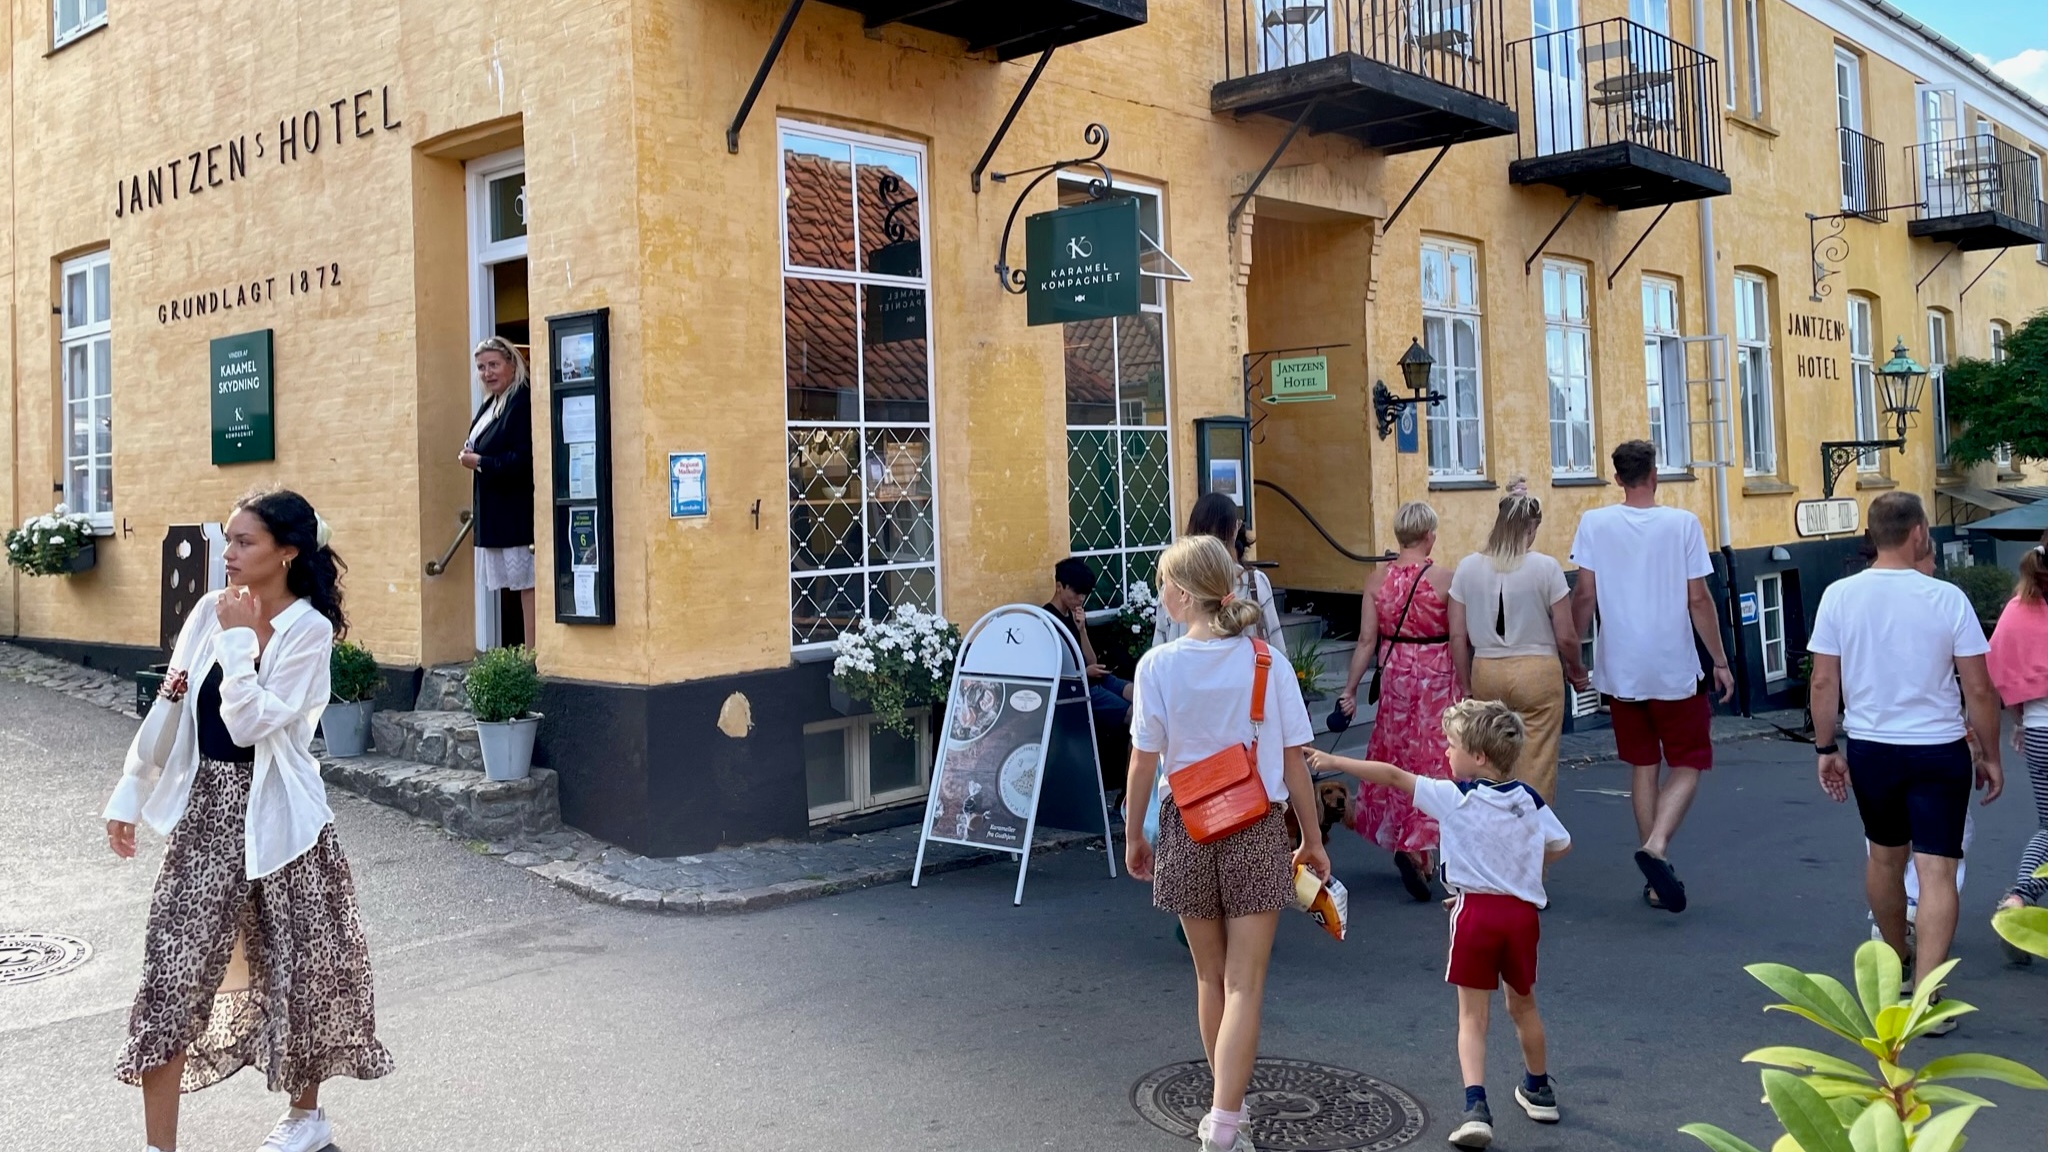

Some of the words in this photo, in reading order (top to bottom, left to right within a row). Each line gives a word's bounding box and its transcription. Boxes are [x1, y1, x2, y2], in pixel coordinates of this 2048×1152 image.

[279, 85, 401, 164] HOTEL
[1066, 236, 1093, 259] K
[1050, 262, 1109, 278] KARAMEL
[1041, 272, 1120, 291] KOMPAGNIET
[158, 277, 275, 325] GRUNDLAGT
[290, 262, 341, 295] 1872
[220, 360, 257, 378] KARAMEL
[1797, 354, 1840, 380] HOTEL
[218, 376, 260, 394] SKYDNING
[1283, 377, 1317, 388] HOTEL
[580, 534, 587, 546] 6
[989, 824, 1016, 833] Karameller
[994, 832, 1017, 841] Gudhjem
